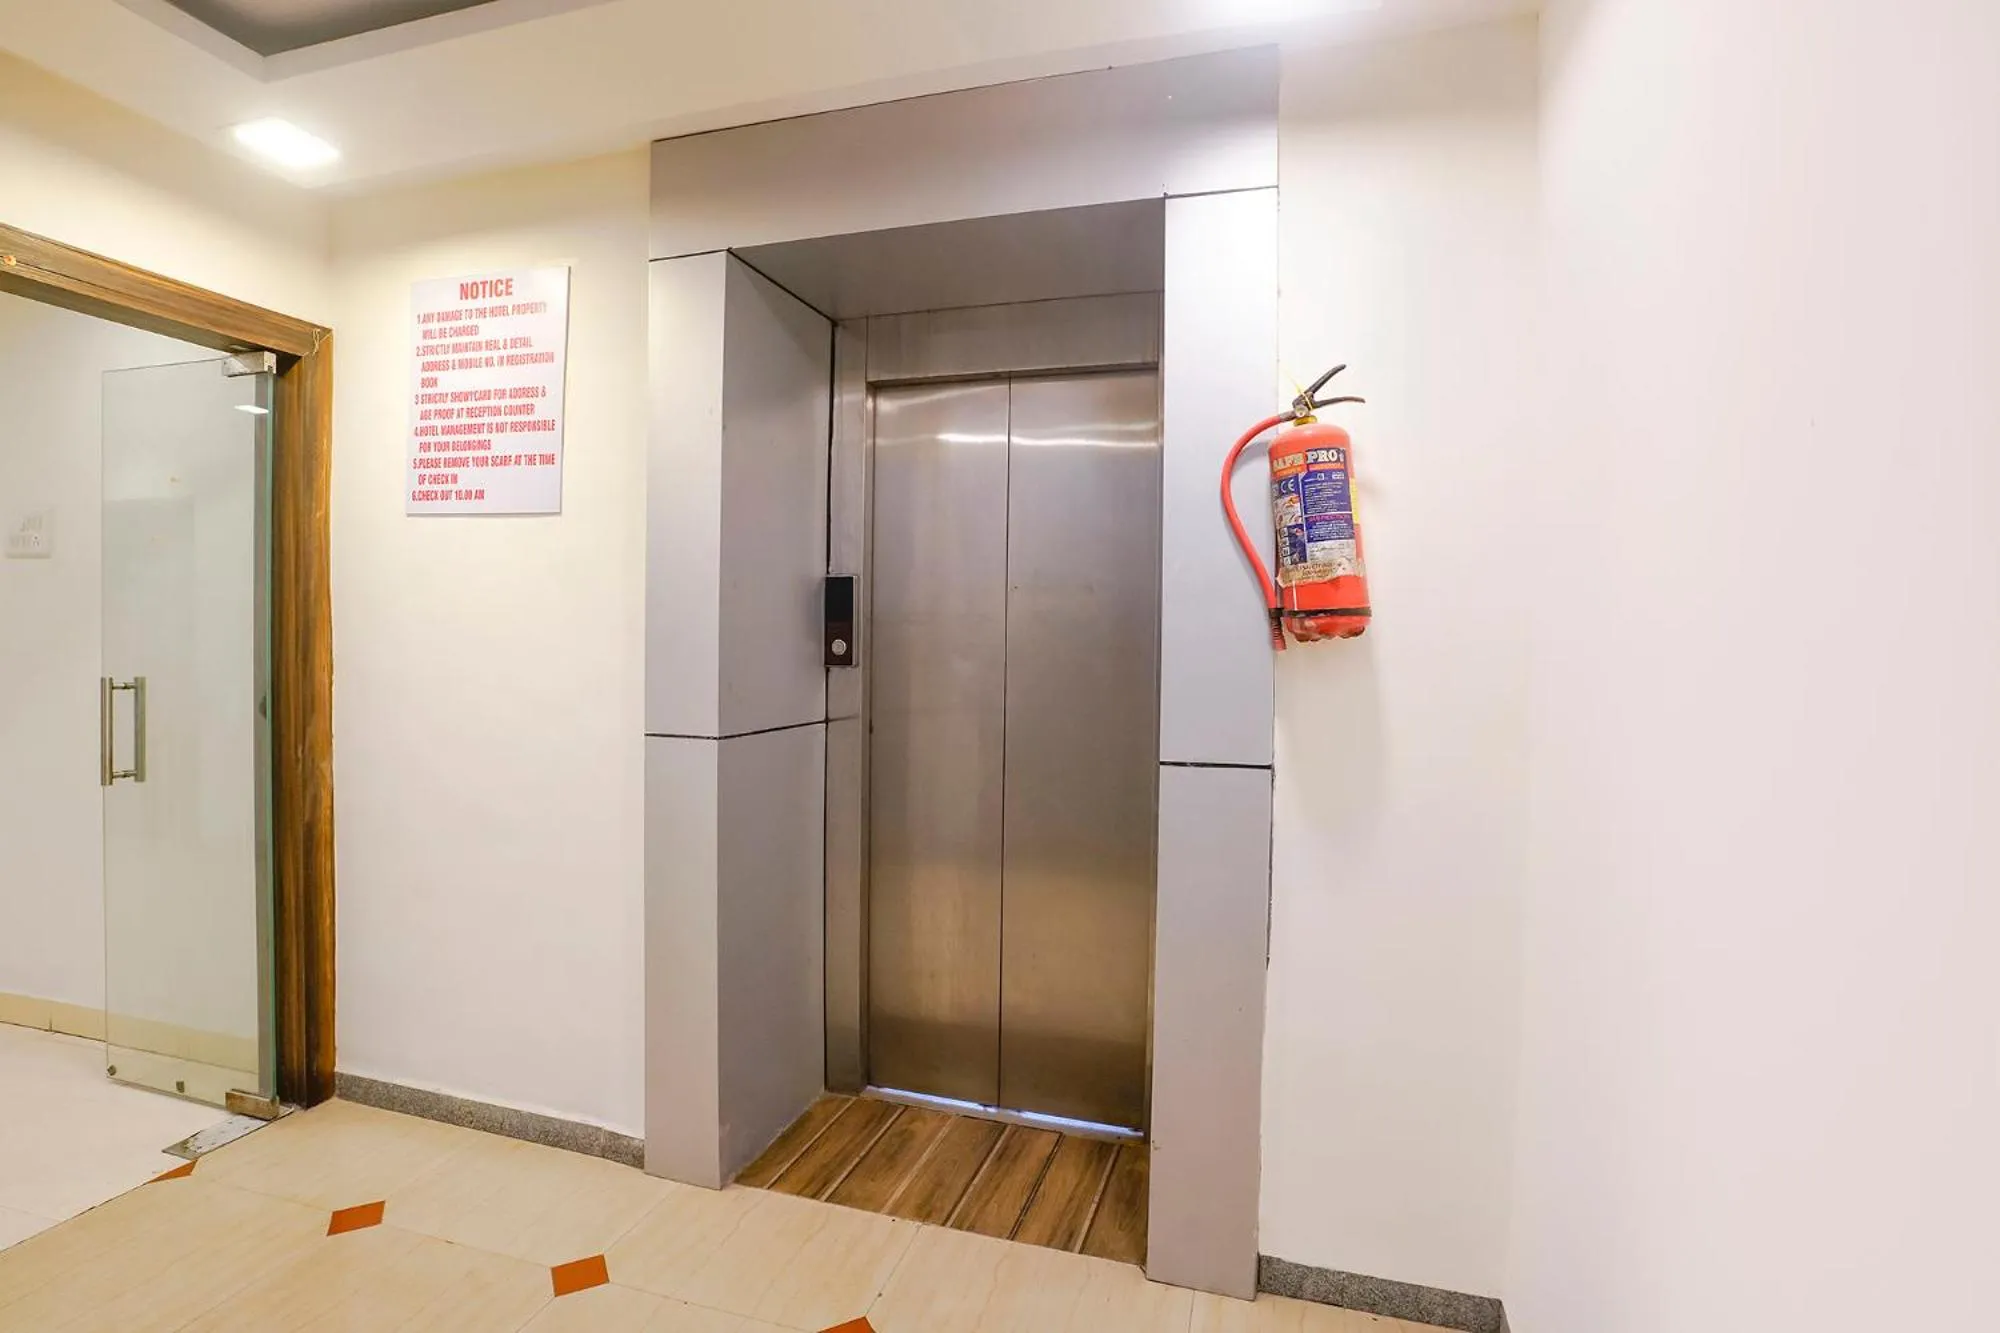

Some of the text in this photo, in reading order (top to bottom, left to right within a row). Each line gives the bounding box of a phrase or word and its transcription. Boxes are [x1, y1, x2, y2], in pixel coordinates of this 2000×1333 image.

[459, 278, 514, 300] NOTICE
[437, 309, 462, 323] DAMAGE
[464, 308, 473, 321] TO
[475, 307, 488, 319] THE
[489, 305, 510, 318] HOTEL
[511, 302, 547, 316] PROPERTY
[422, 324, 479, 340] WILL BE CHARGED
[452, 340, 483, 354] MAINTAIN
[485, 339, 501, 351] REAL
[502, 338, 508, 350] &
[509, 336, 533, 349] DETAIL
[421, 359, 450, 372] ADDRESS
[451, 358, 457, 370] &
[458, 357, 483, 369] MOBILE
[497, 354, 505, 366] IN
[506, 351, 555, 366] REGISTRATION
[420, 377, 438, 388] BOOK
[493, 387, 507, 400] FOR
[508, 386, 540, 399] ADDRESS
[540, 385, 546, 397] &
[419, 403, 536, 421] AGE PROOF AT RECEPTION COUNTER
[440, 422, 486, 436] MANAGEMENT
[486, 422, 494, 434] IS
[495, 421, 509, 434] NOT
[510, 419, 556, 433] RESPONSIBLE
[418, 439, 492, 453] FOR YOUR BELONGINGS
[443, 456, 470, 469] REMOVE
[471, 455, 489, 468] YOUR
[490, 455, 512, 467] SCARF
[513, 454, 522, 466] AT
[524, 454, 537, 466] THE
[538, 453, 556, 466] TIME
[418, 473, 459, 486] OF CHECK IN
[440, 489, 453, 501] OUT
[454, 489, 473, 501] 10.00
[474, 489, 485, 501] AM
